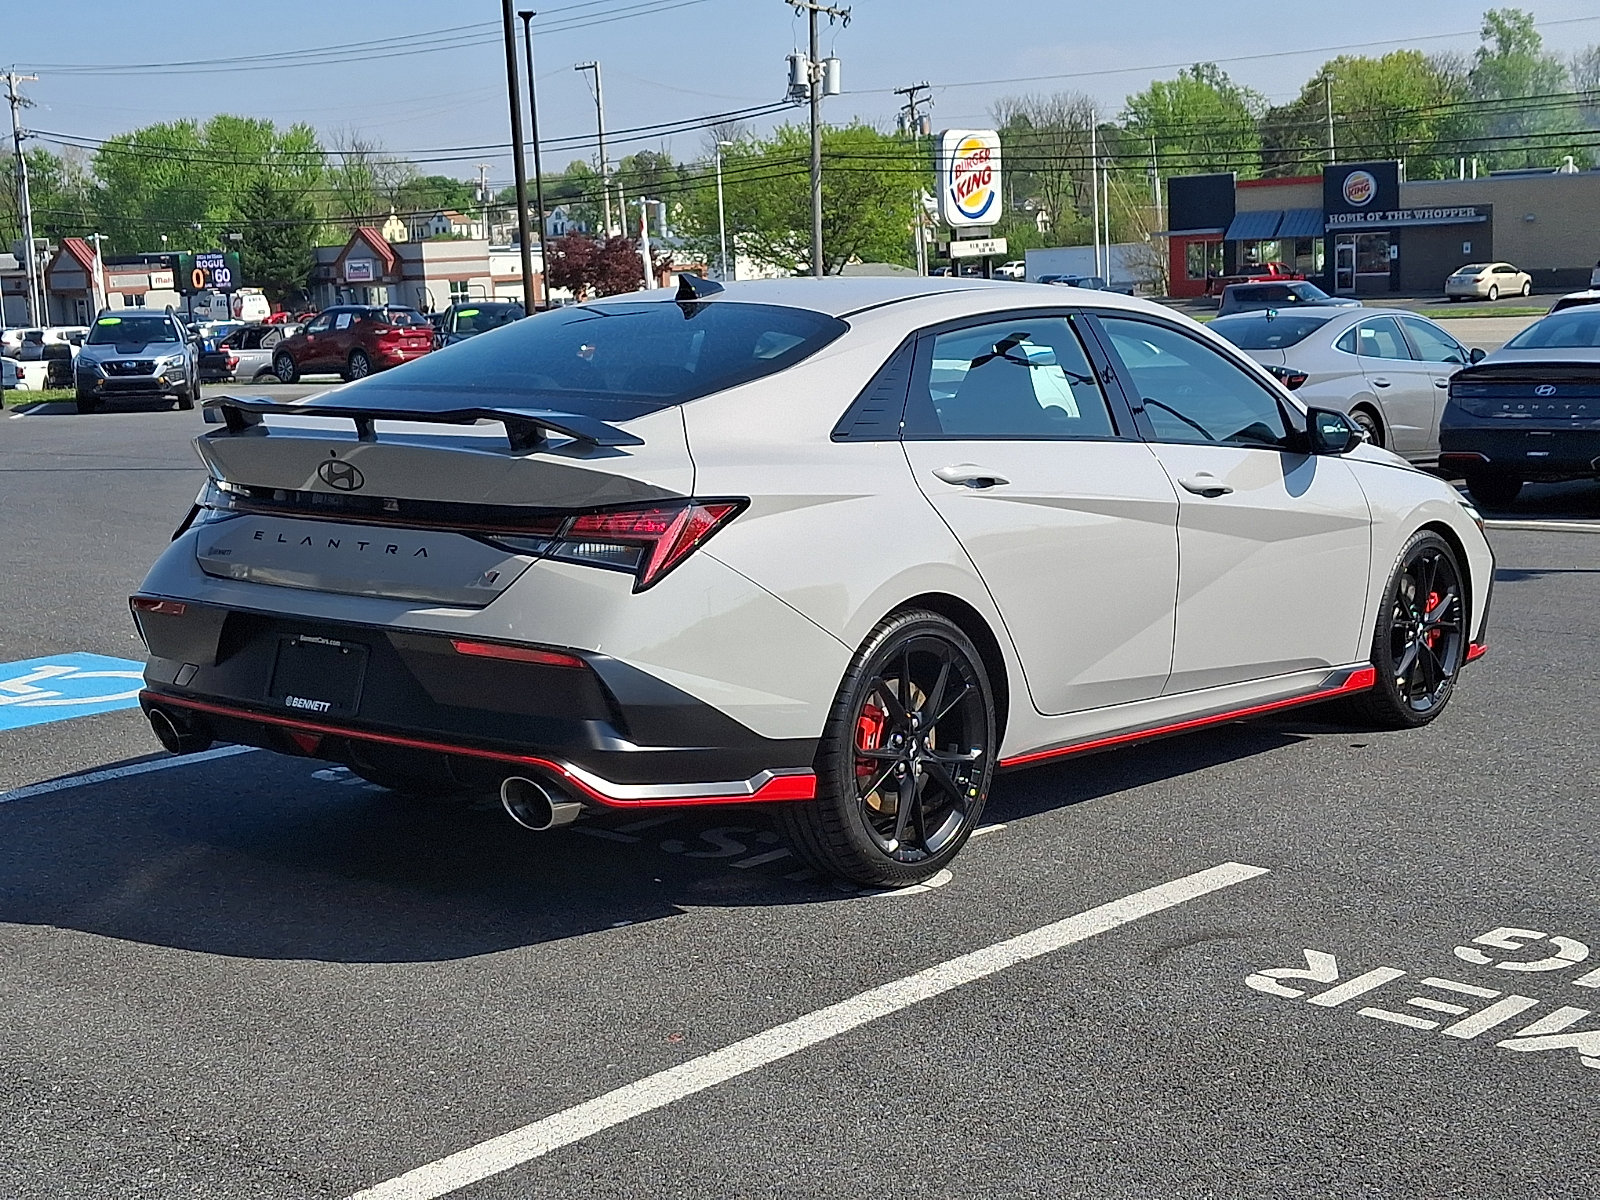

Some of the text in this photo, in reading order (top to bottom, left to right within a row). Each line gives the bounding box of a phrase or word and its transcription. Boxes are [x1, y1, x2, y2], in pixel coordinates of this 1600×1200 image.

[954, 148, 991, 180] BURGER
[956, 165, 992, 203] KING
[1329, 207, 1476, 223] HOME OF THE WHOPPER
[196, 259, 224, 268] ROGUE
[215, 268, 231, 283] 60
[253, 530, 428, 557] ELANTRA
